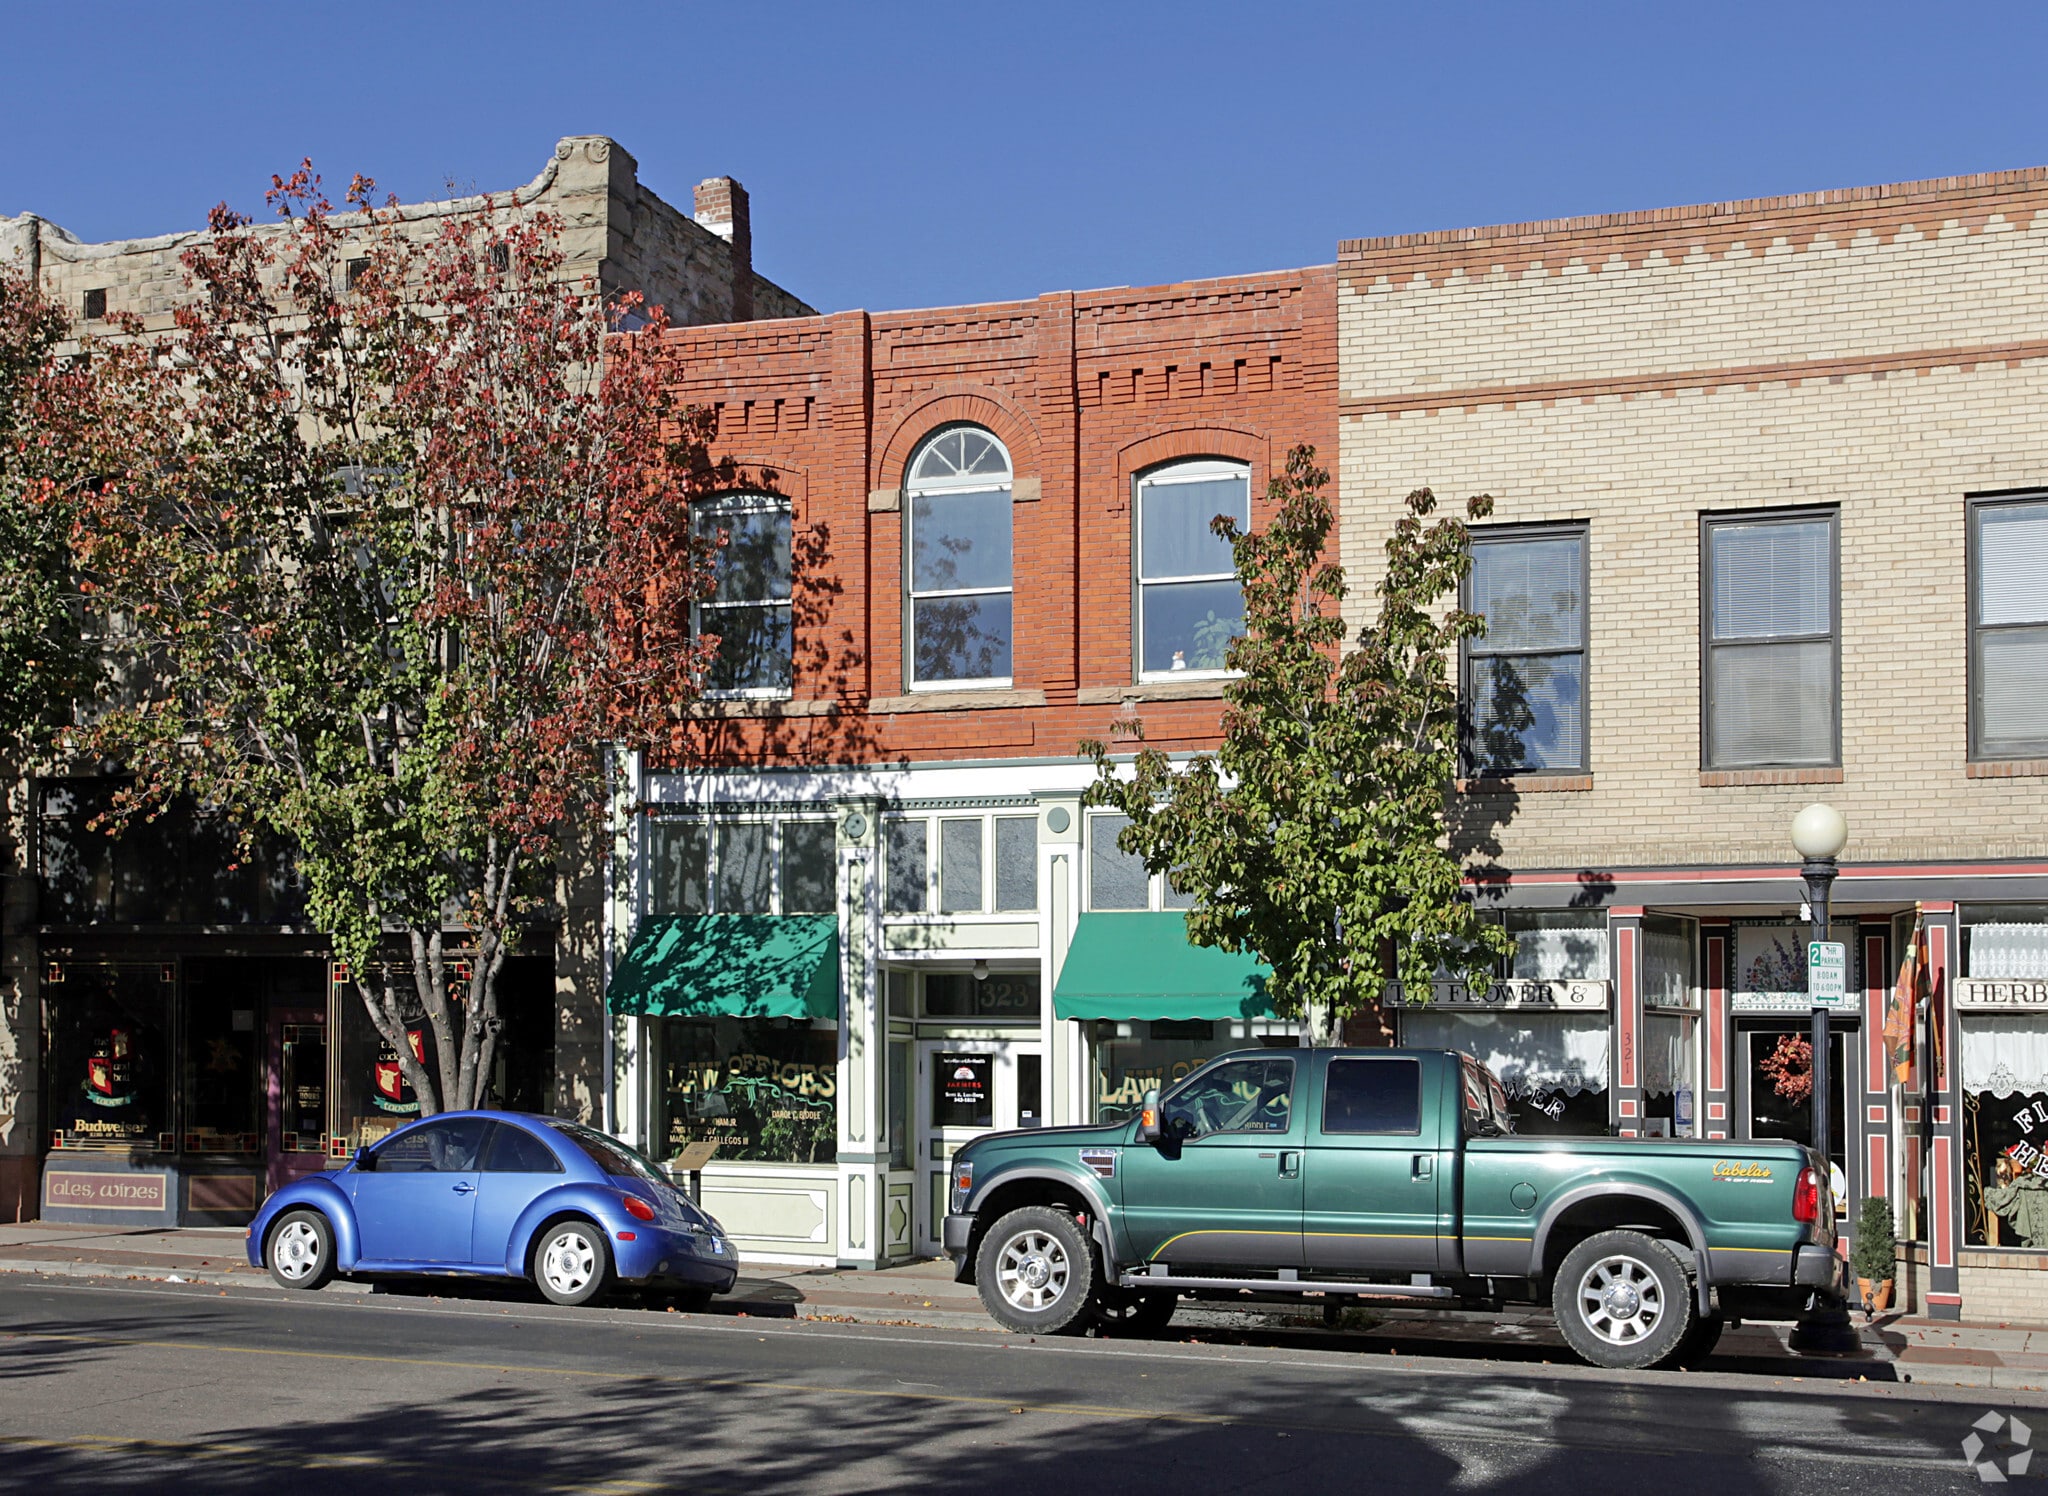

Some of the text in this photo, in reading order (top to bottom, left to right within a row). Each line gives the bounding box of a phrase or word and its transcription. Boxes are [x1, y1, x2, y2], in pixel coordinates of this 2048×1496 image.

[1811, 947, 1820, 964] 2
[1828, 947, 1837, 955] HR
[1822, 957, 1844, 965] PARKING
[981, 983, 1028, 1007] 323
[1448, 985, 1555, 1003] FLOWER
[1570, 985, 1587, 1003] &
[1813, 983, 1820, 991] TO
[1821, 983, 1833, 991] 6:00
[1624, 1032, 1632, 1074] 321
[666, 1054, 836, 1097] LAW OFFICES
[1099, 1068, 1163, 1104] LAW
[74, 1119, 148, 1133] Budweiser
[709, 1136, 742, 1145] GALLEGOS
[1712, 1160, 1772, 1177] Cabela's
[53, 1180, 159, 1199] ales, wines
